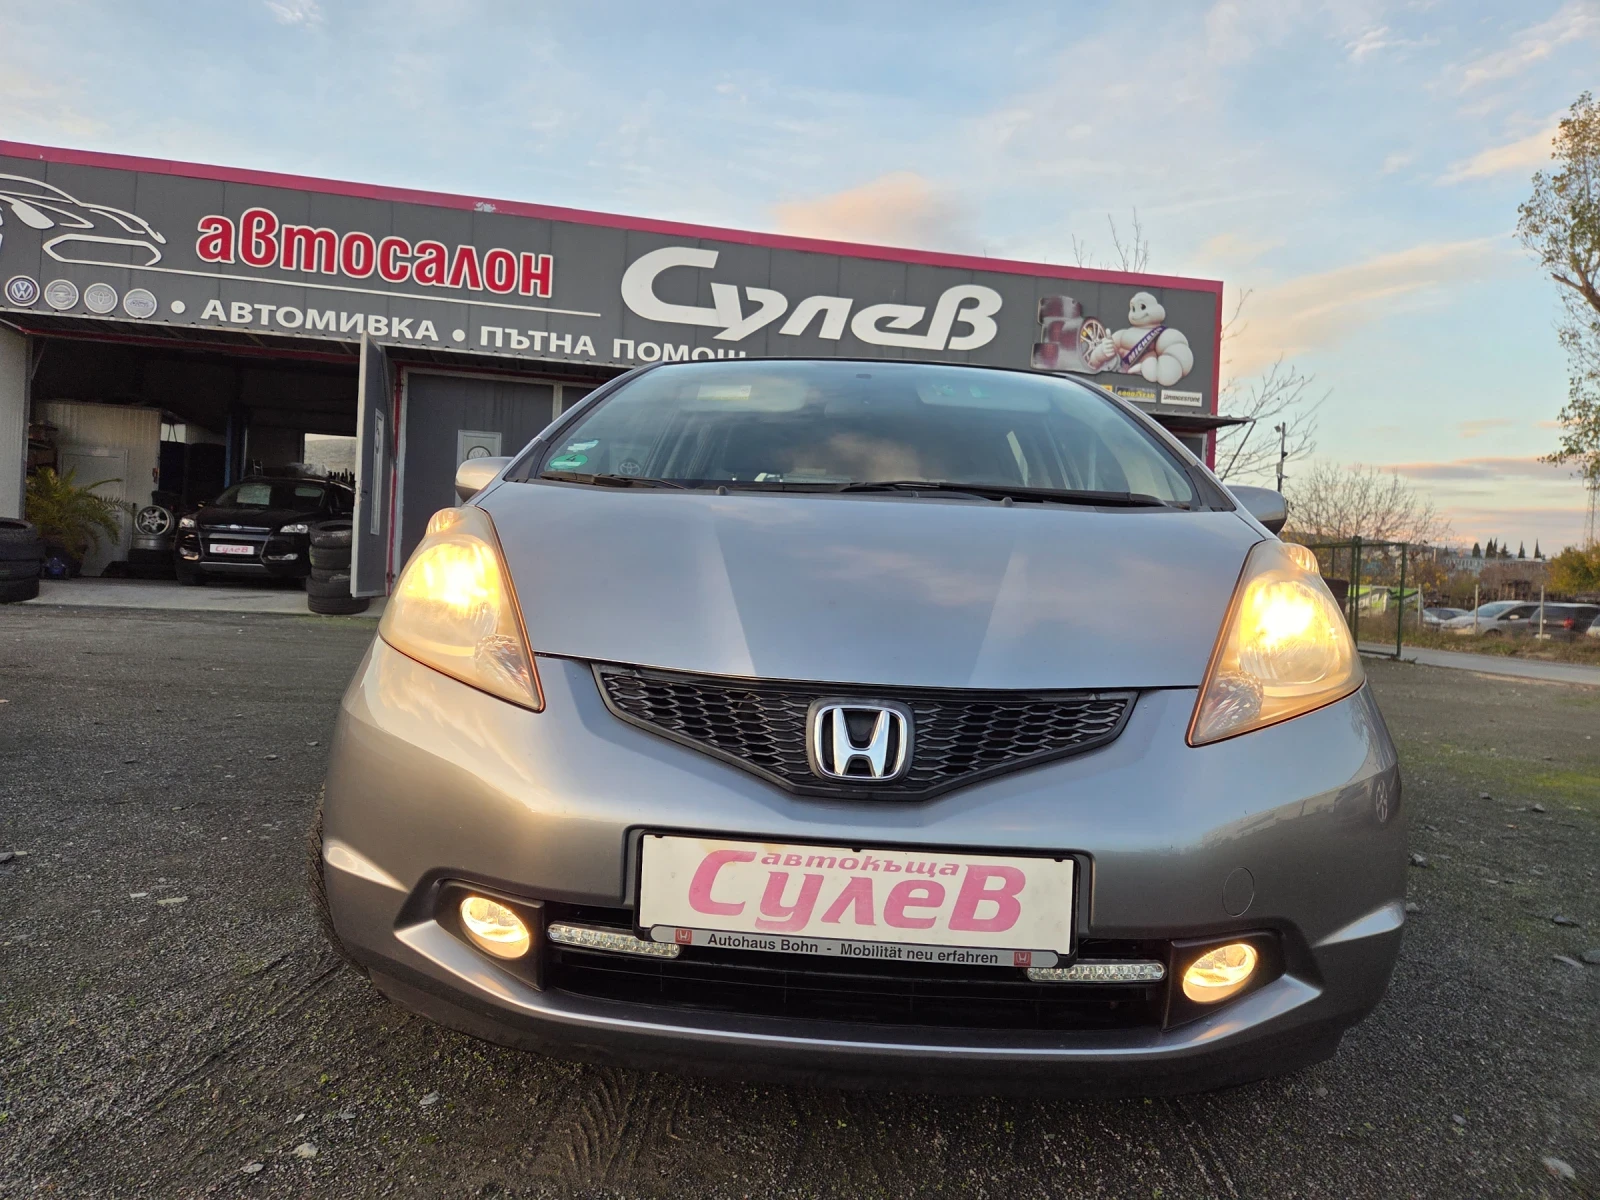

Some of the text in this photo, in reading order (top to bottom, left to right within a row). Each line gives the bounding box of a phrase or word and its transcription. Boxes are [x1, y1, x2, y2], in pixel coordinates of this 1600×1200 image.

[196, 207, 553, 298] автосалон
[200, 299, 439, 341] АВТОМИВКА
[480, 325, 597, 356] ПЪТНА
[760, 852, 960, 878] автокъща
[707, 934, 776, 950] Autohaus
[780, 939, 819, 953] Bohn
[840, 943, 903, 958] Mobilität
[906, 949, 934, 961] neu
[937, 951, 999, 964] erfahren
